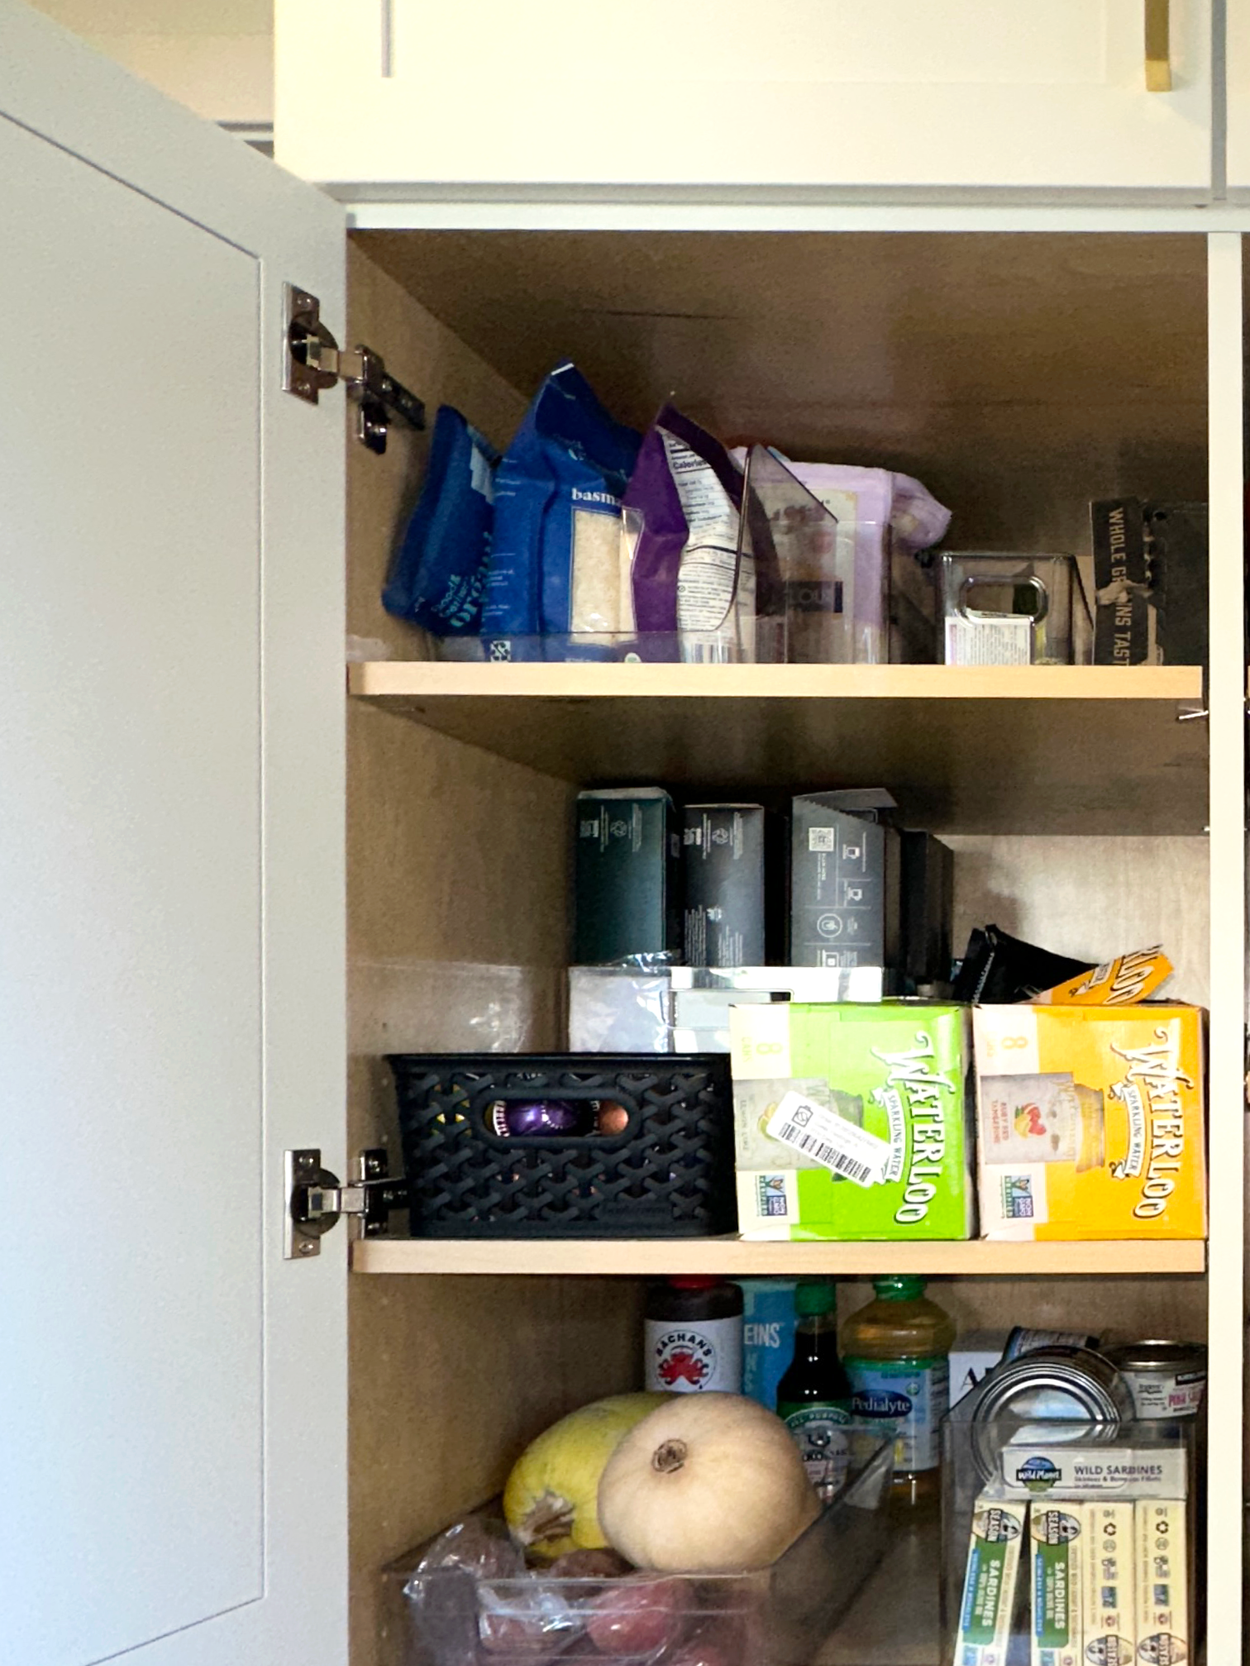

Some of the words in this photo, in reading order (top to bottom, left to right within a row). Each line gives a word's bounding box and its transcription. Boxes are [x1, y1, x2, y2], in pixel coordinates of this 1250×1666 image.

[1109, 507, 1127, 564] WHOLE
[870, 1030, 955, 1225] WATERLOO
[888, 1094, 901, 1143] SPARKLING
[1110, 1026, 1195, 1219] WATERLOO
[1127, 1089, 1141, 1140] SPARKLING
[889, 1147, 902, 1177] WATER
[1127, 1142, 1141, 1171] WATER
[851, 1396, 911, 1414] Pedialyte
[1018, 1469, 1036, 1480] Wild
[1074, 1465, 1103, 1475] WILD
[1106, 1465, 1163, 1475] SARDINES
[987, 1509, 1002, 1542] SEASON
[1048, 1510, 1059, 1545] SEASON
[982, 1559, 1000, 1627] SARDINES
[1054, 1562, 1066, 1630] SARDINES
